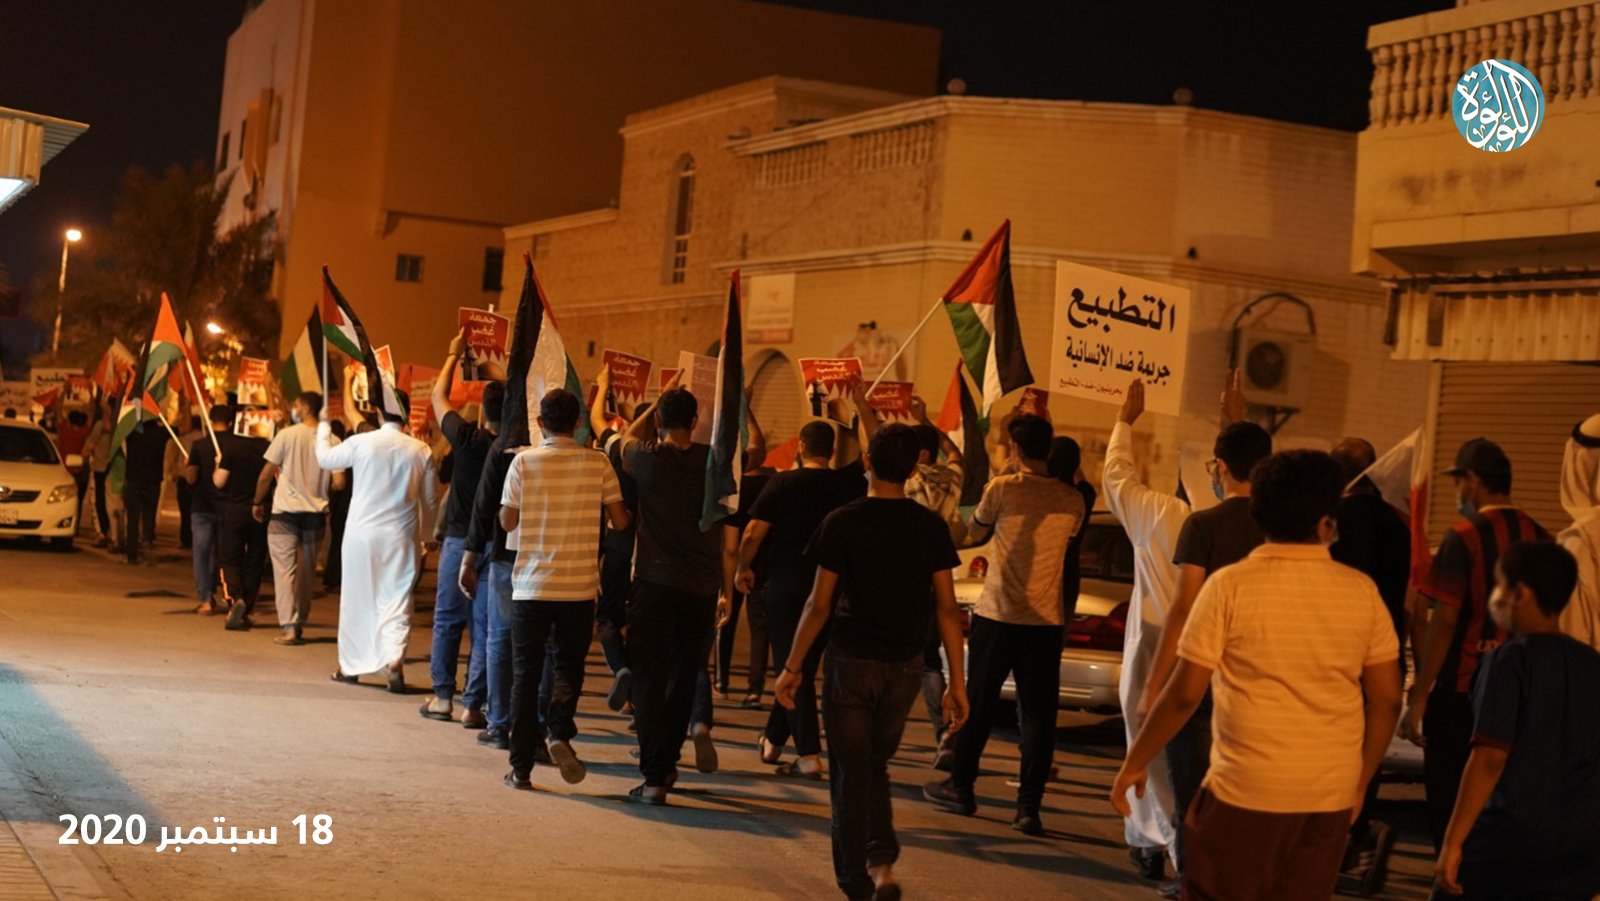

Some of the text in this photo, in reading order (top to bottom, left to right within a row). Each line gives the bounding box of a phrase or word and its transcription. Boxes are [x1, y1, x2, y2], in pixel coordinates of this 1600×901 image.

[469, 311, 497, 325] جمعة
[1067, 286, 1175, 333] التطبيع
[471, 325, 495, 337] غضب
[1066, 336, 1171, 386] جريمة ضد الإنسانية
